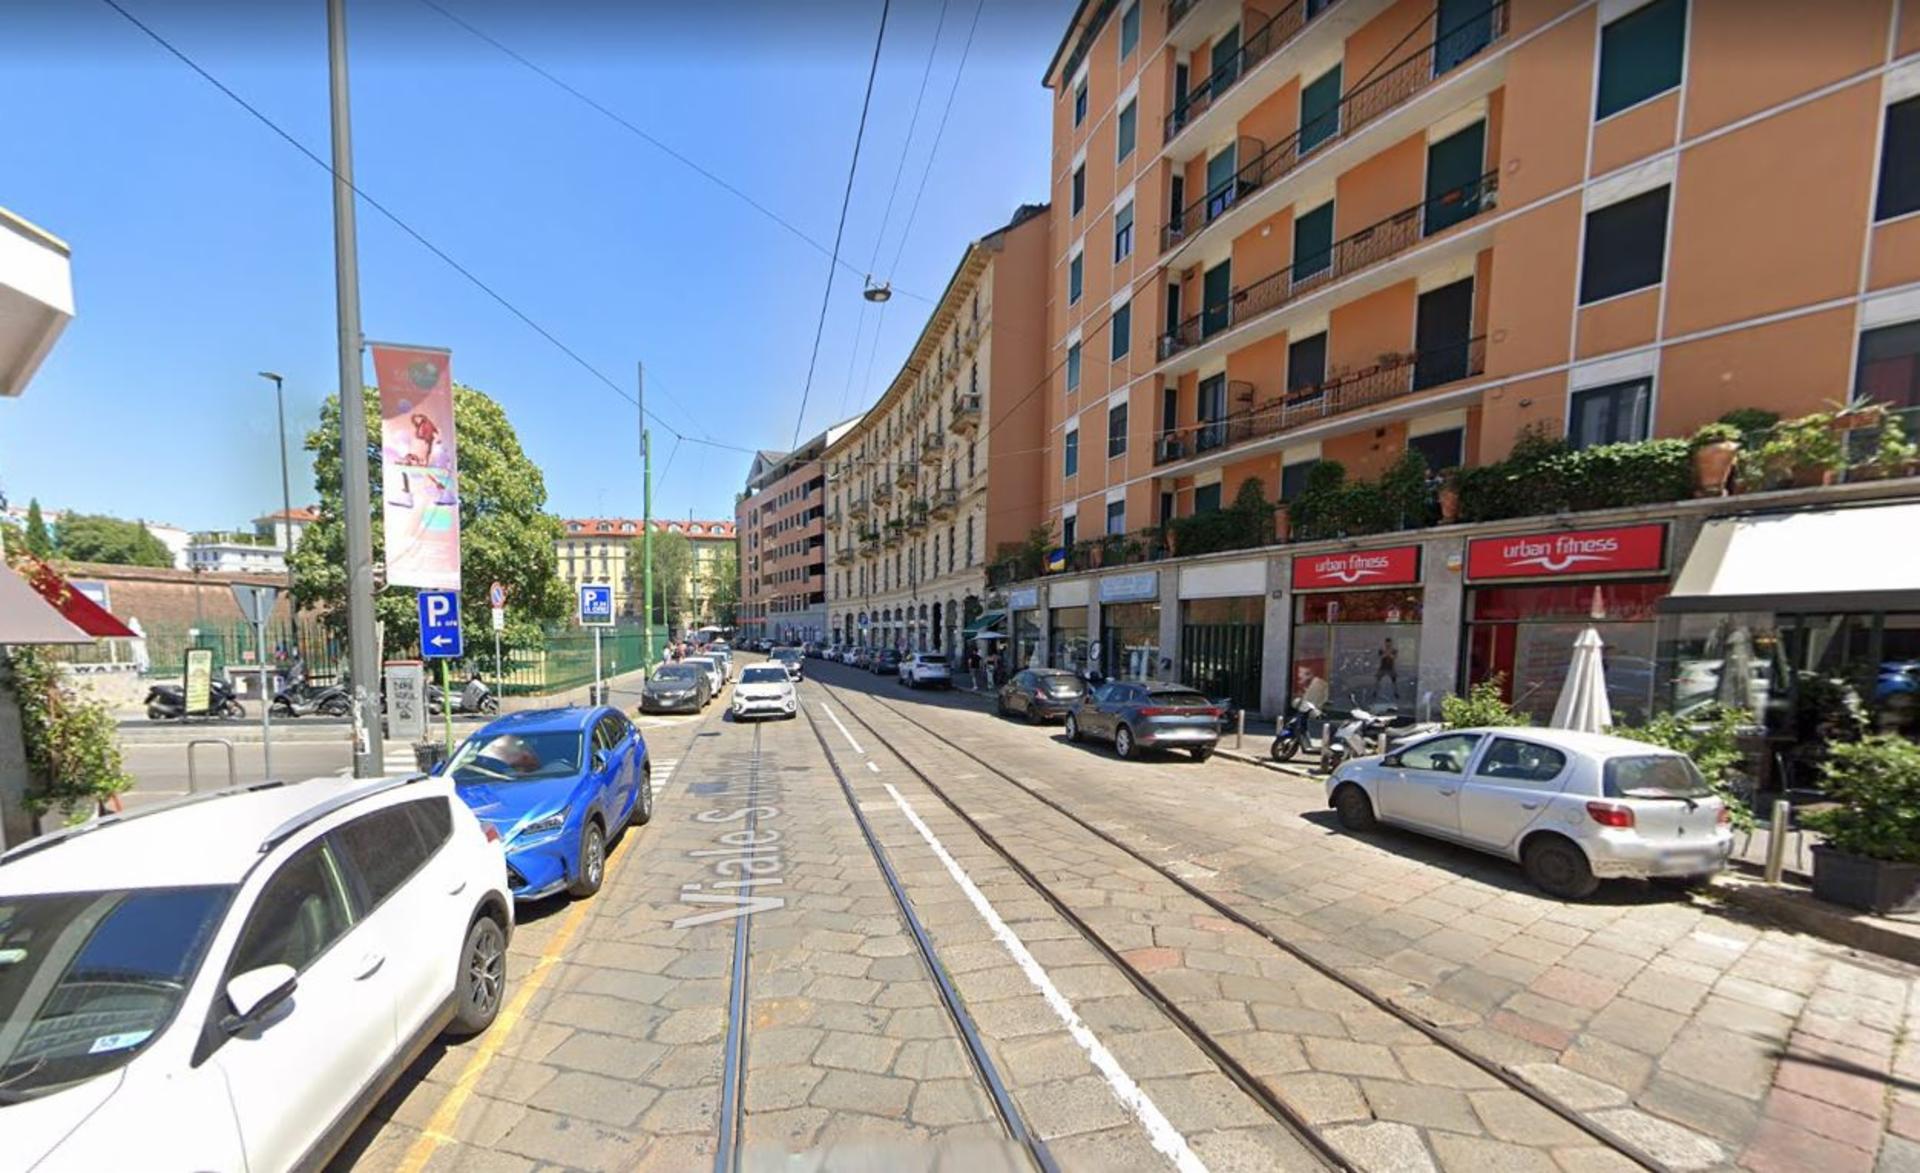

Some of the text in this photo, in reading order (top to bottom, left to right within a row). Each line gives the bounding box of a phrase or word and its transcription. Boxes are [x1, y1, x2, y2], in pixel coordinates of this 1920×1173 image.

[1503, 536, 1619, 558] urban fitness
[1315, 554, 1390, 573] urban fitness
[584, 590, 598, 608] P
[427, 595, 450, 628] P
